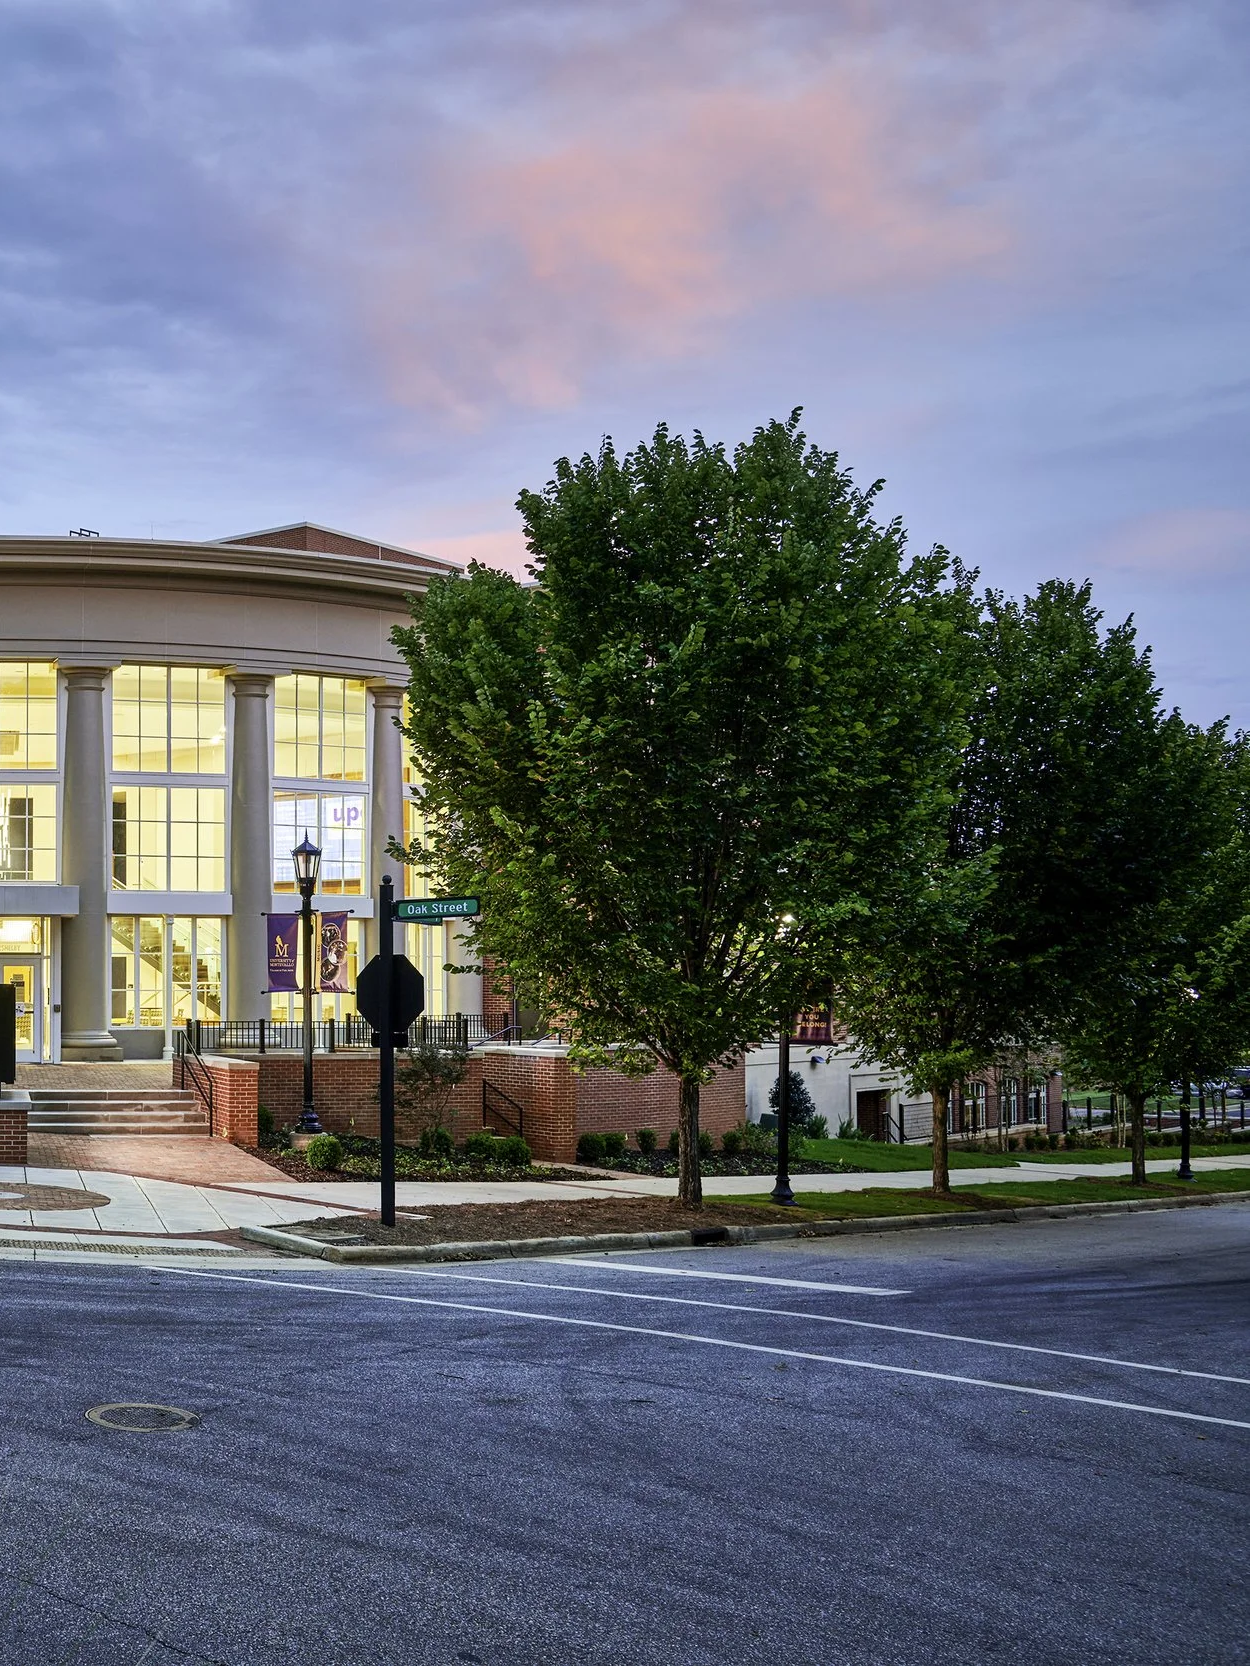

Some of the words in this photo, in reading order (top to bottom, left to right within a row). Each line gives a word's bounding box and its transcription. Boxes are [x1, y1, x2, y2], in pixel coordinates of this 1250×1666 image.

[333, 806, 362, 827] up
[407, 904, 427, 915] Oak
[432, 902, 468, 914] Street
